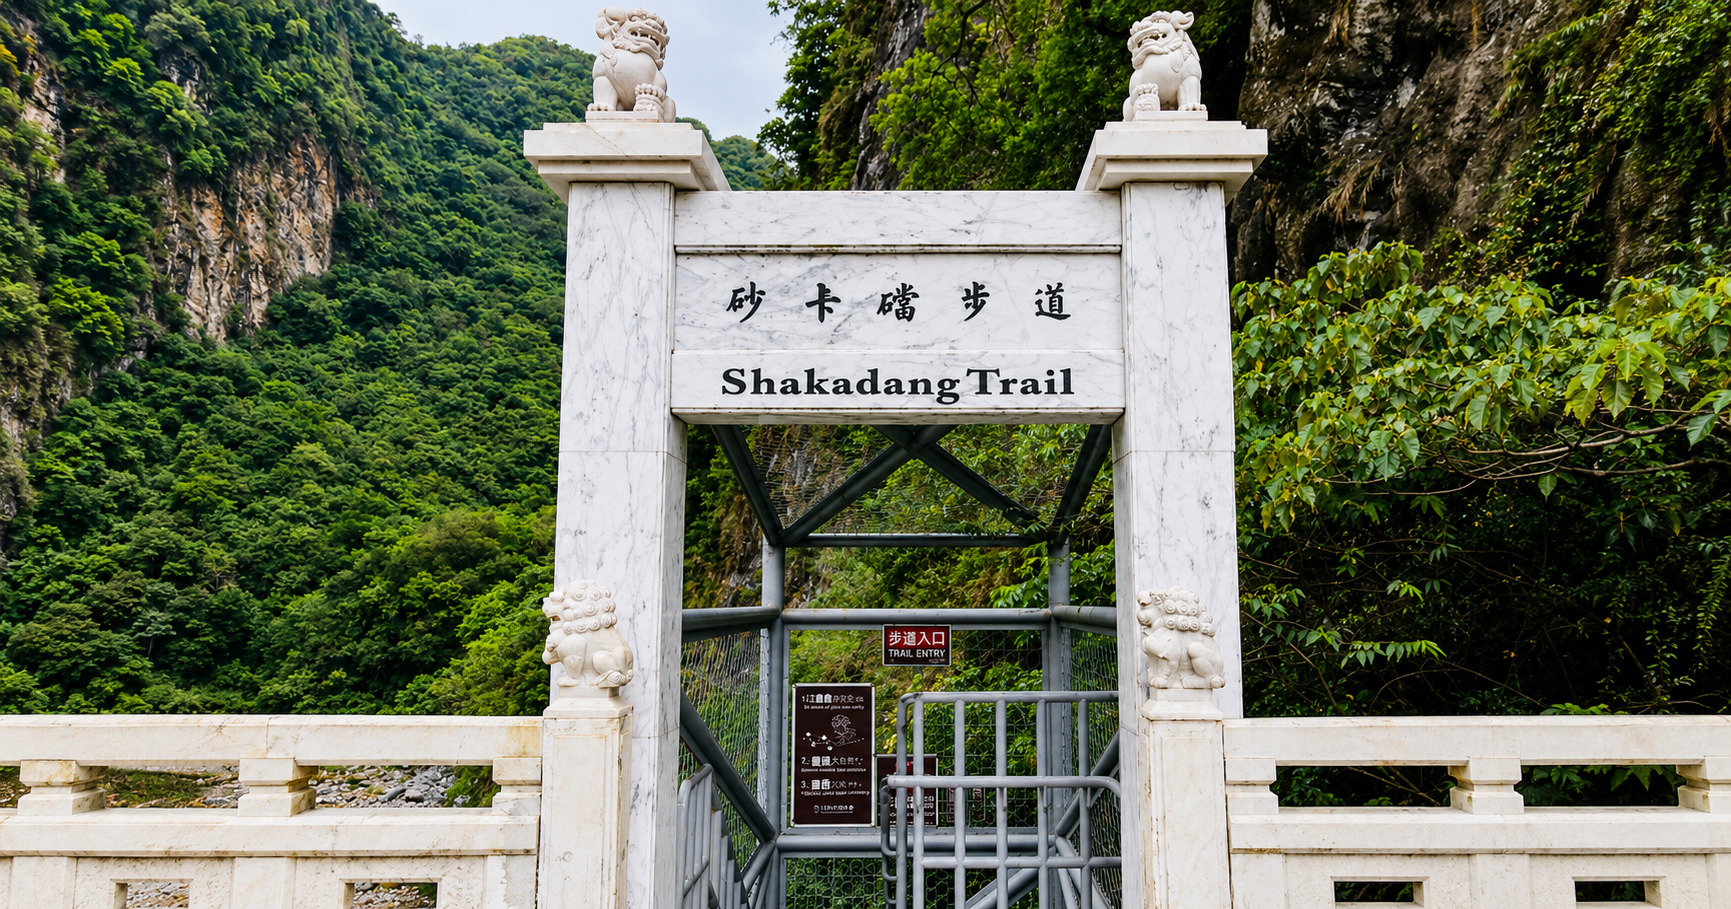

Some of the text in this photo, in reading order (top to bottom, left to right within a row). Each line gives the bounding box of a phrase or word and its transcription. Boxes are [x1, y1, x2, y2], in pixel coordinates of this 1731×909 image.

[727, 281, 1071, 323] 砂卡礑步道
[721, 368, 1075, 405] Shakadang Trail
[889, 630, 945, 646] 步道入口
[888, 648, 946, 658] TRAIL ENTRY
